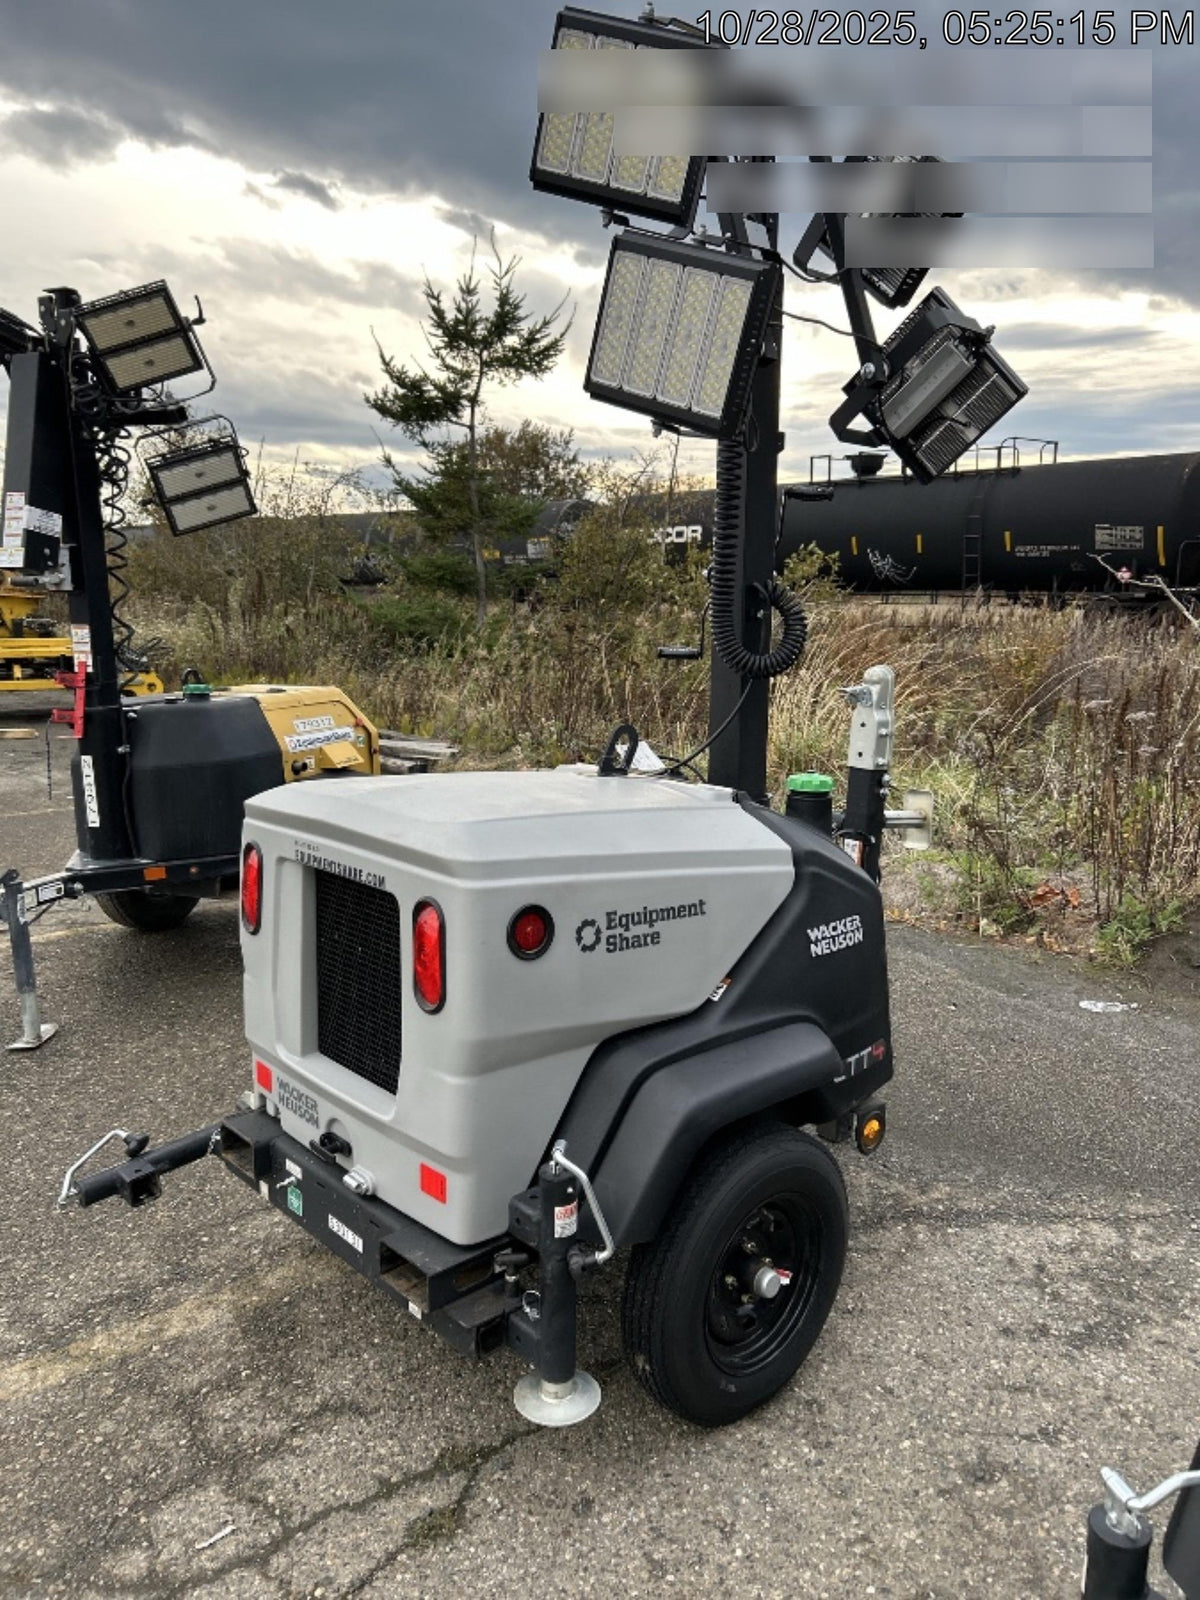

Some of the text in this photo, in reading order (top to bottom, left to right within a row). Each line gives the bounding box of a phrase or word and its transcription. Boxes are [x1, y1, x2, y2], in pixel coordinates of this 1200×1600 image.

[605, 898, 706, 931] Equipment
[806, 914, 862, 942] WACKER
[605, 930, 661, 953] Share
[810, 928, 864, 957] NEUSON
[278, 1091, 319, 1129] NEUSON
